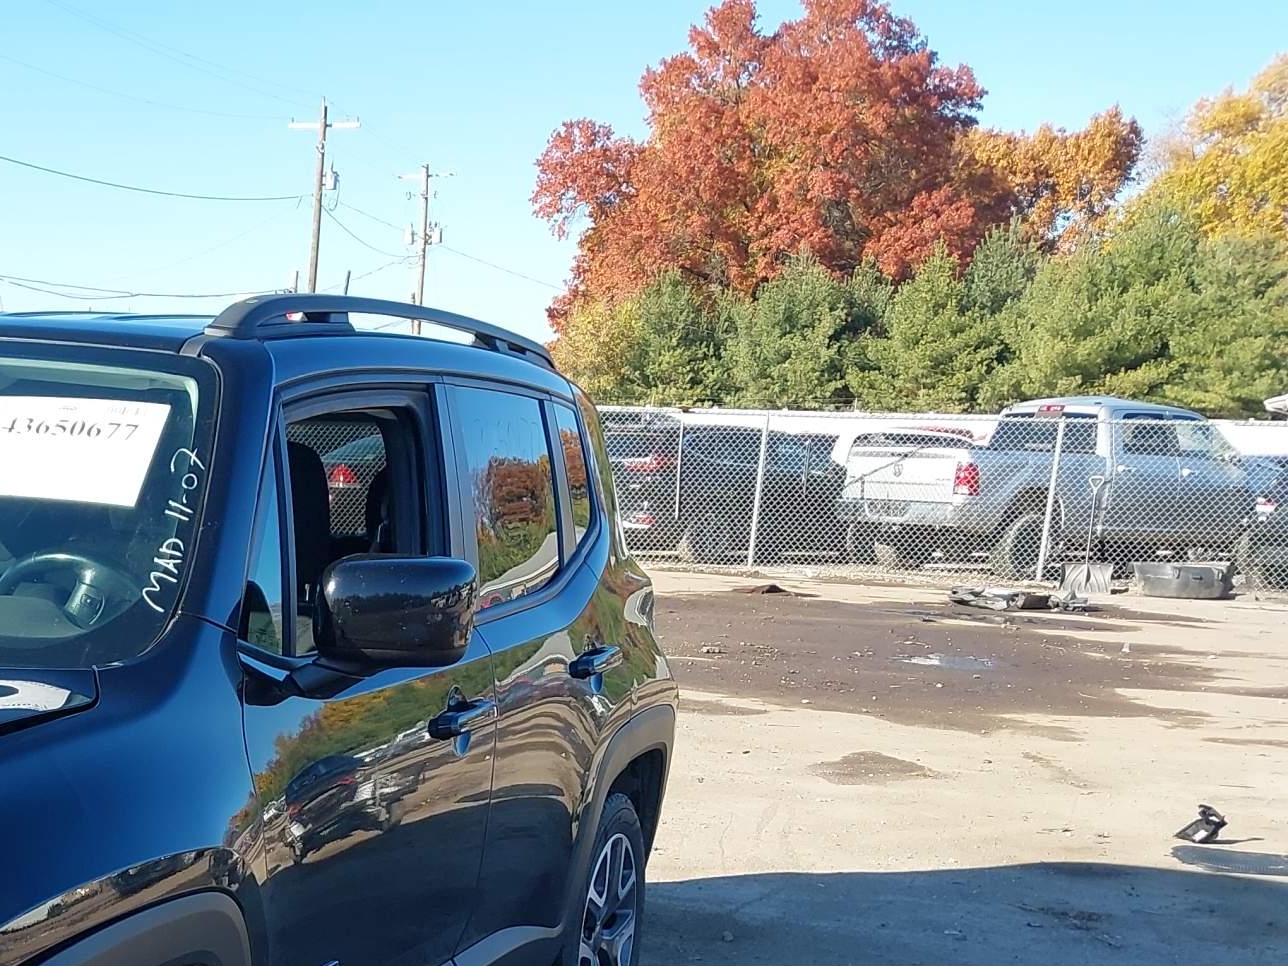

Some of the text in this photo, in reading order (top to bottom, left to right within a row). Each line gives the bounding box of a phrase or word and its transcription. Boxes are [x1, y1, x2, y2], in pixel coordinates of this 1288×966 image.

[0, 416, 140, 441] 43650677
[142, 447, 206, 613] MAD 11-07
